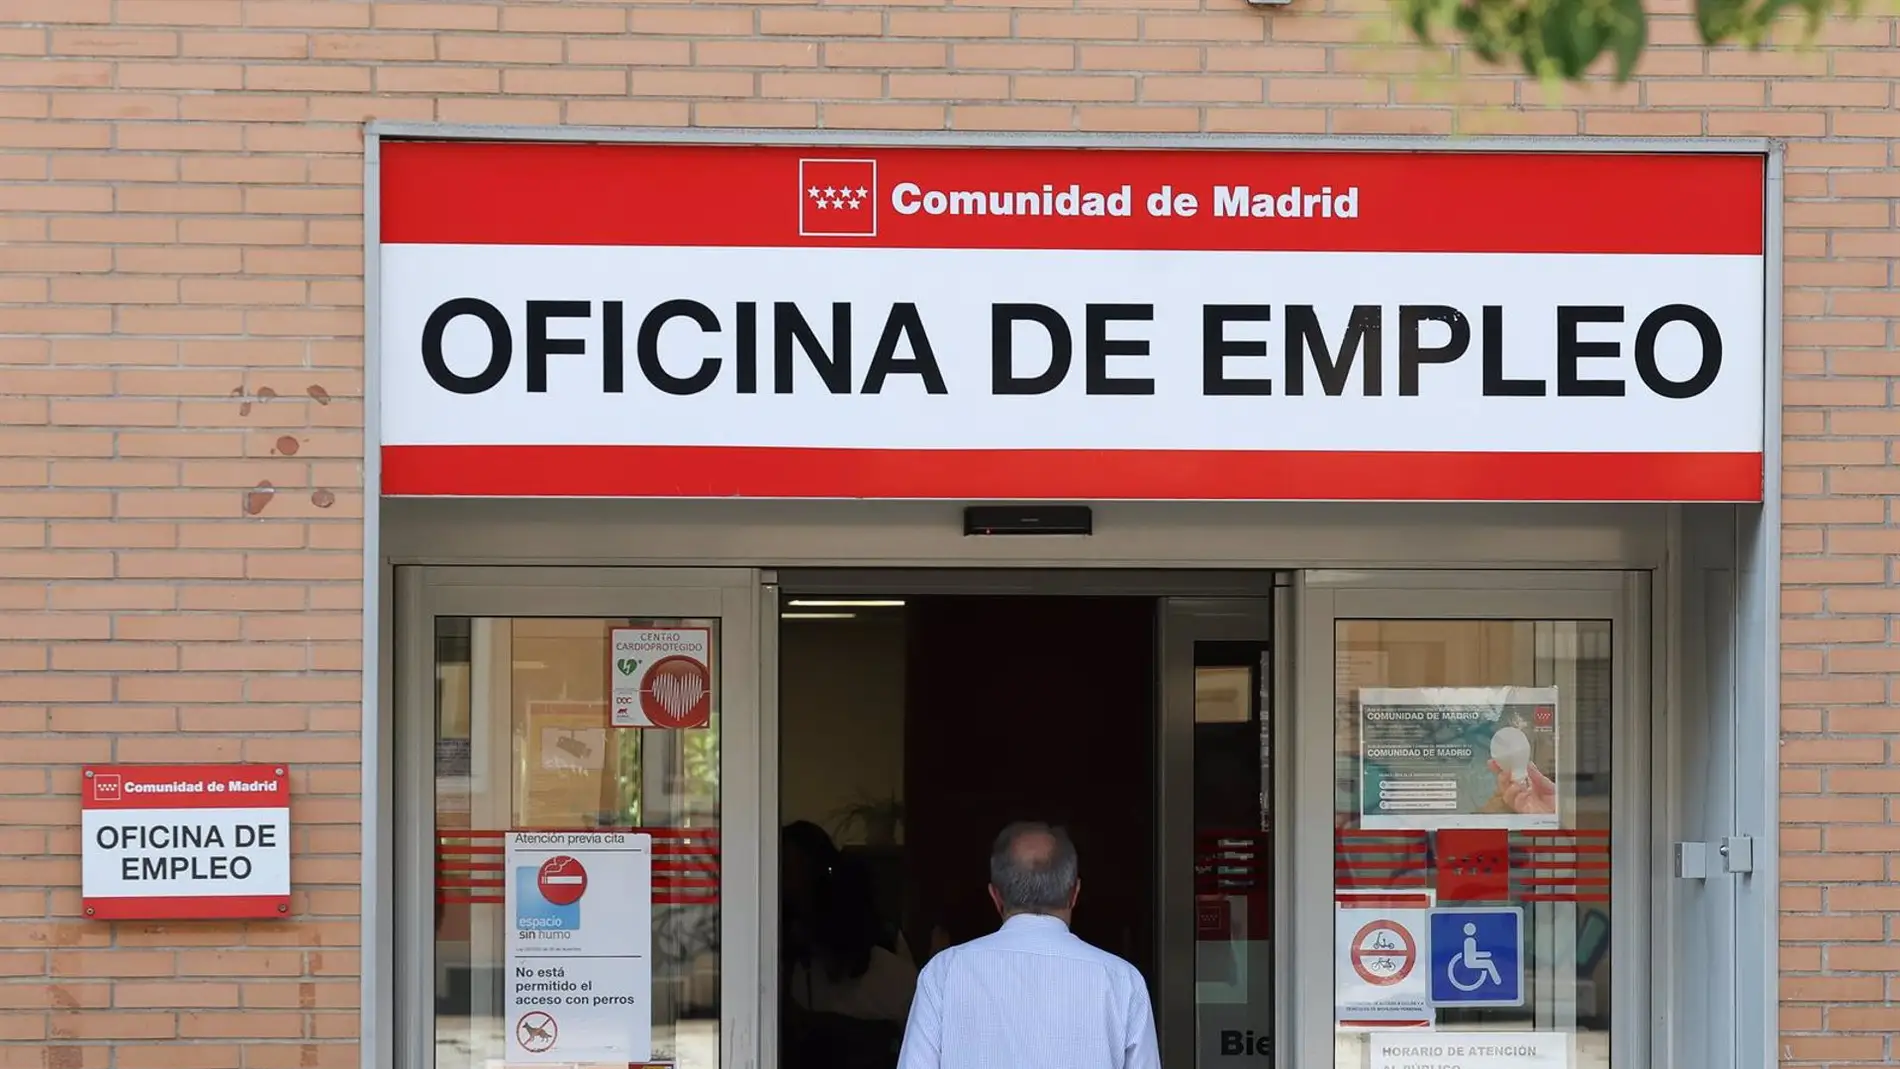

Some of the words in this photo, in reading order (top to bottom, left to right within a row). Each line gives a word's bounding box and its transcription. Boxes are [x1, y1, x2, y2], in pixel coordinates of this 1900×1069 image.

[892, 183, 1130, 216] Comunidad
[1147, 186, 1197, 216] de
[1214, 186, 1357, 218] Madrid
[422, 298, 948, 395] OFICINA
[992, 303, 1154, 395] DE
[1203, 304, 1722, 398] EMPLEO
[641, 633, 681, 642] CENTRO
[616, 643, 703, 652] CARDIOPROTEGIDO
[1367, 712, 1425, 720] COMUNIDAD
[1427, 712, 1439, 720] DE
[1442, 712, 1479, 720] MADRID
[1367, 749, 1421, 757] COMUNIDAD
[1423, 749, 1436, 757] DE
[1437, 749, 1472, 757] MADRID
[125, 781, 204, 793] Comunidad
[208, 781, 225, 792] de
[229, 781, 278, 792] Madrid
[97, 825, 224, 849] OFICINA
[236, 825, 275, 847] DE
[515, 832, 565, 844] Atención
[568, 832, 602, 846] previa
[604, 832, 625, 844] cita
[123, 856, 251, 880] EMPLEO
[519, 915, 563, 929] espacio
[519, 929, 536, 940] sin
[538, 929, 571, 940] humo
[515, 967, 533, 978] No
[537, 966, 565, 978] está
[516, 981, 576, 993] permitido
[581, 981, 591, 991] el
[515, 996, 562, 1006] acceso
[565, 996, 590, 1006] con
[594, 996, 635, 1008] perros
[1383, 1047, 1442, 1056] HORARIO
[1448, 1047, 1464, 1056] DE
[1469, 1045, 1537, 1056] ATENCIÓN
